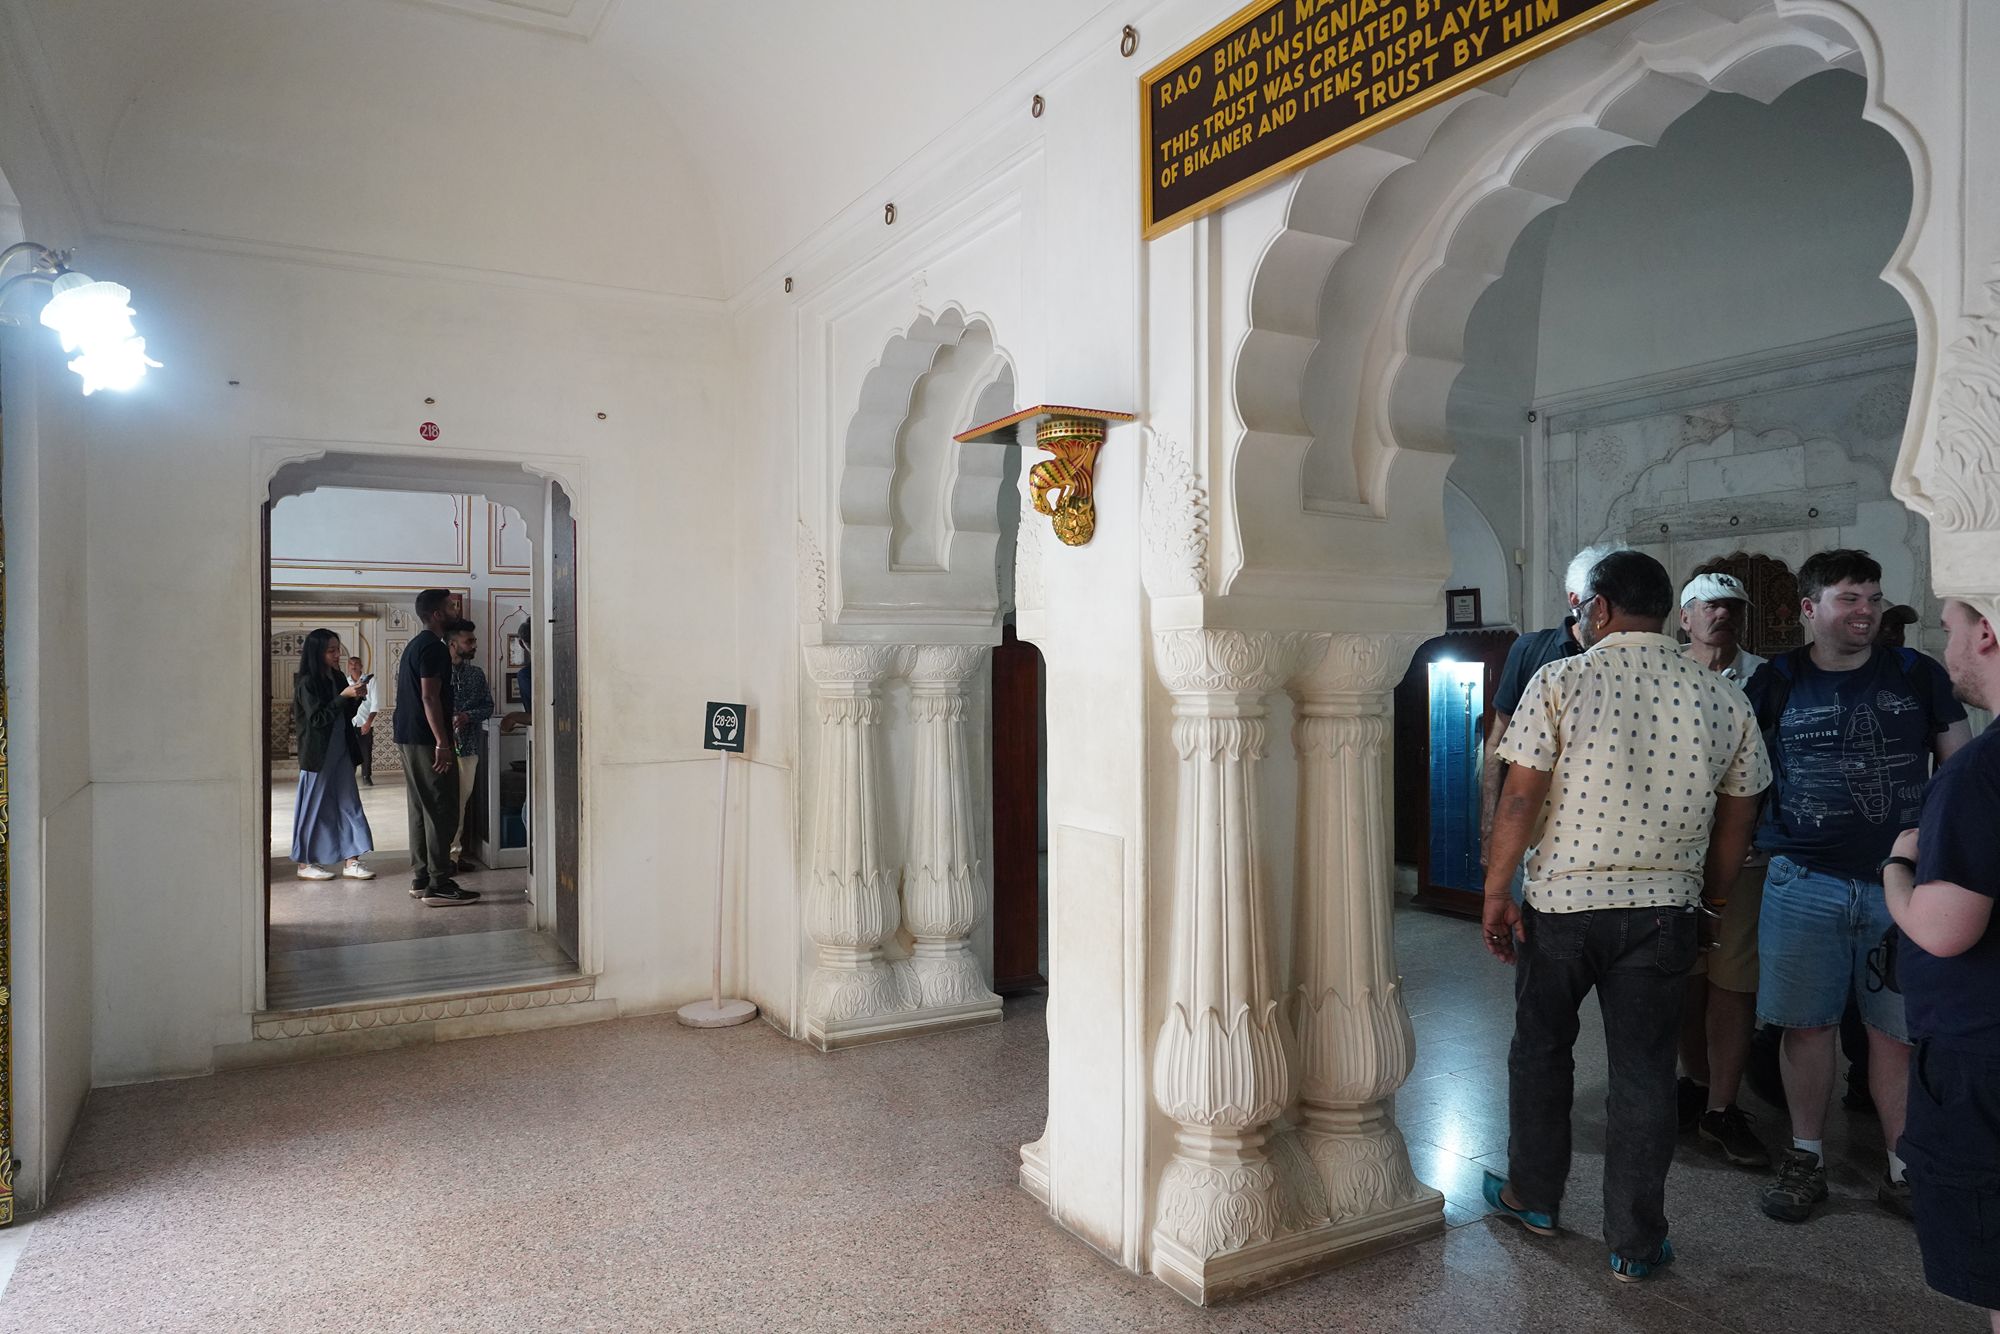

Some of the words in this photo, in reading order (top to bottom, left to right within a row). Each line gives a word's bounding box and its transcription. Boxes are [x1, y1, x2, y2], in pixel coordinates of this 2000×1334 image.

[1160, 124, 1199, 162] THIS
[1203, 90, 1258, 139] TRUST
[1263, 63, 1304, 105] WAS
[1309, 5, 1408, 79] CREATED
[1161, 65, 1202, 108] RAO
[1214, 9, 1284, 76] BIKAJI
[1212, 60, 1259, 107] AND
[1354, 52, 1439, 115] TRUST
[1453, 25, 1490, 68] BY
[1502, 0, 1559, 44] HIM
[1161, 162, 1179, 189] OF
[1183, 122, 1253, 177] BIKANER
[1257, 98, 1297, 138] AND
[1304, 61, 1363, 113] ITEMS
[715, 715, 736, 727] 28-29
[1794, 730, 1839, 740] SPITFIRE
